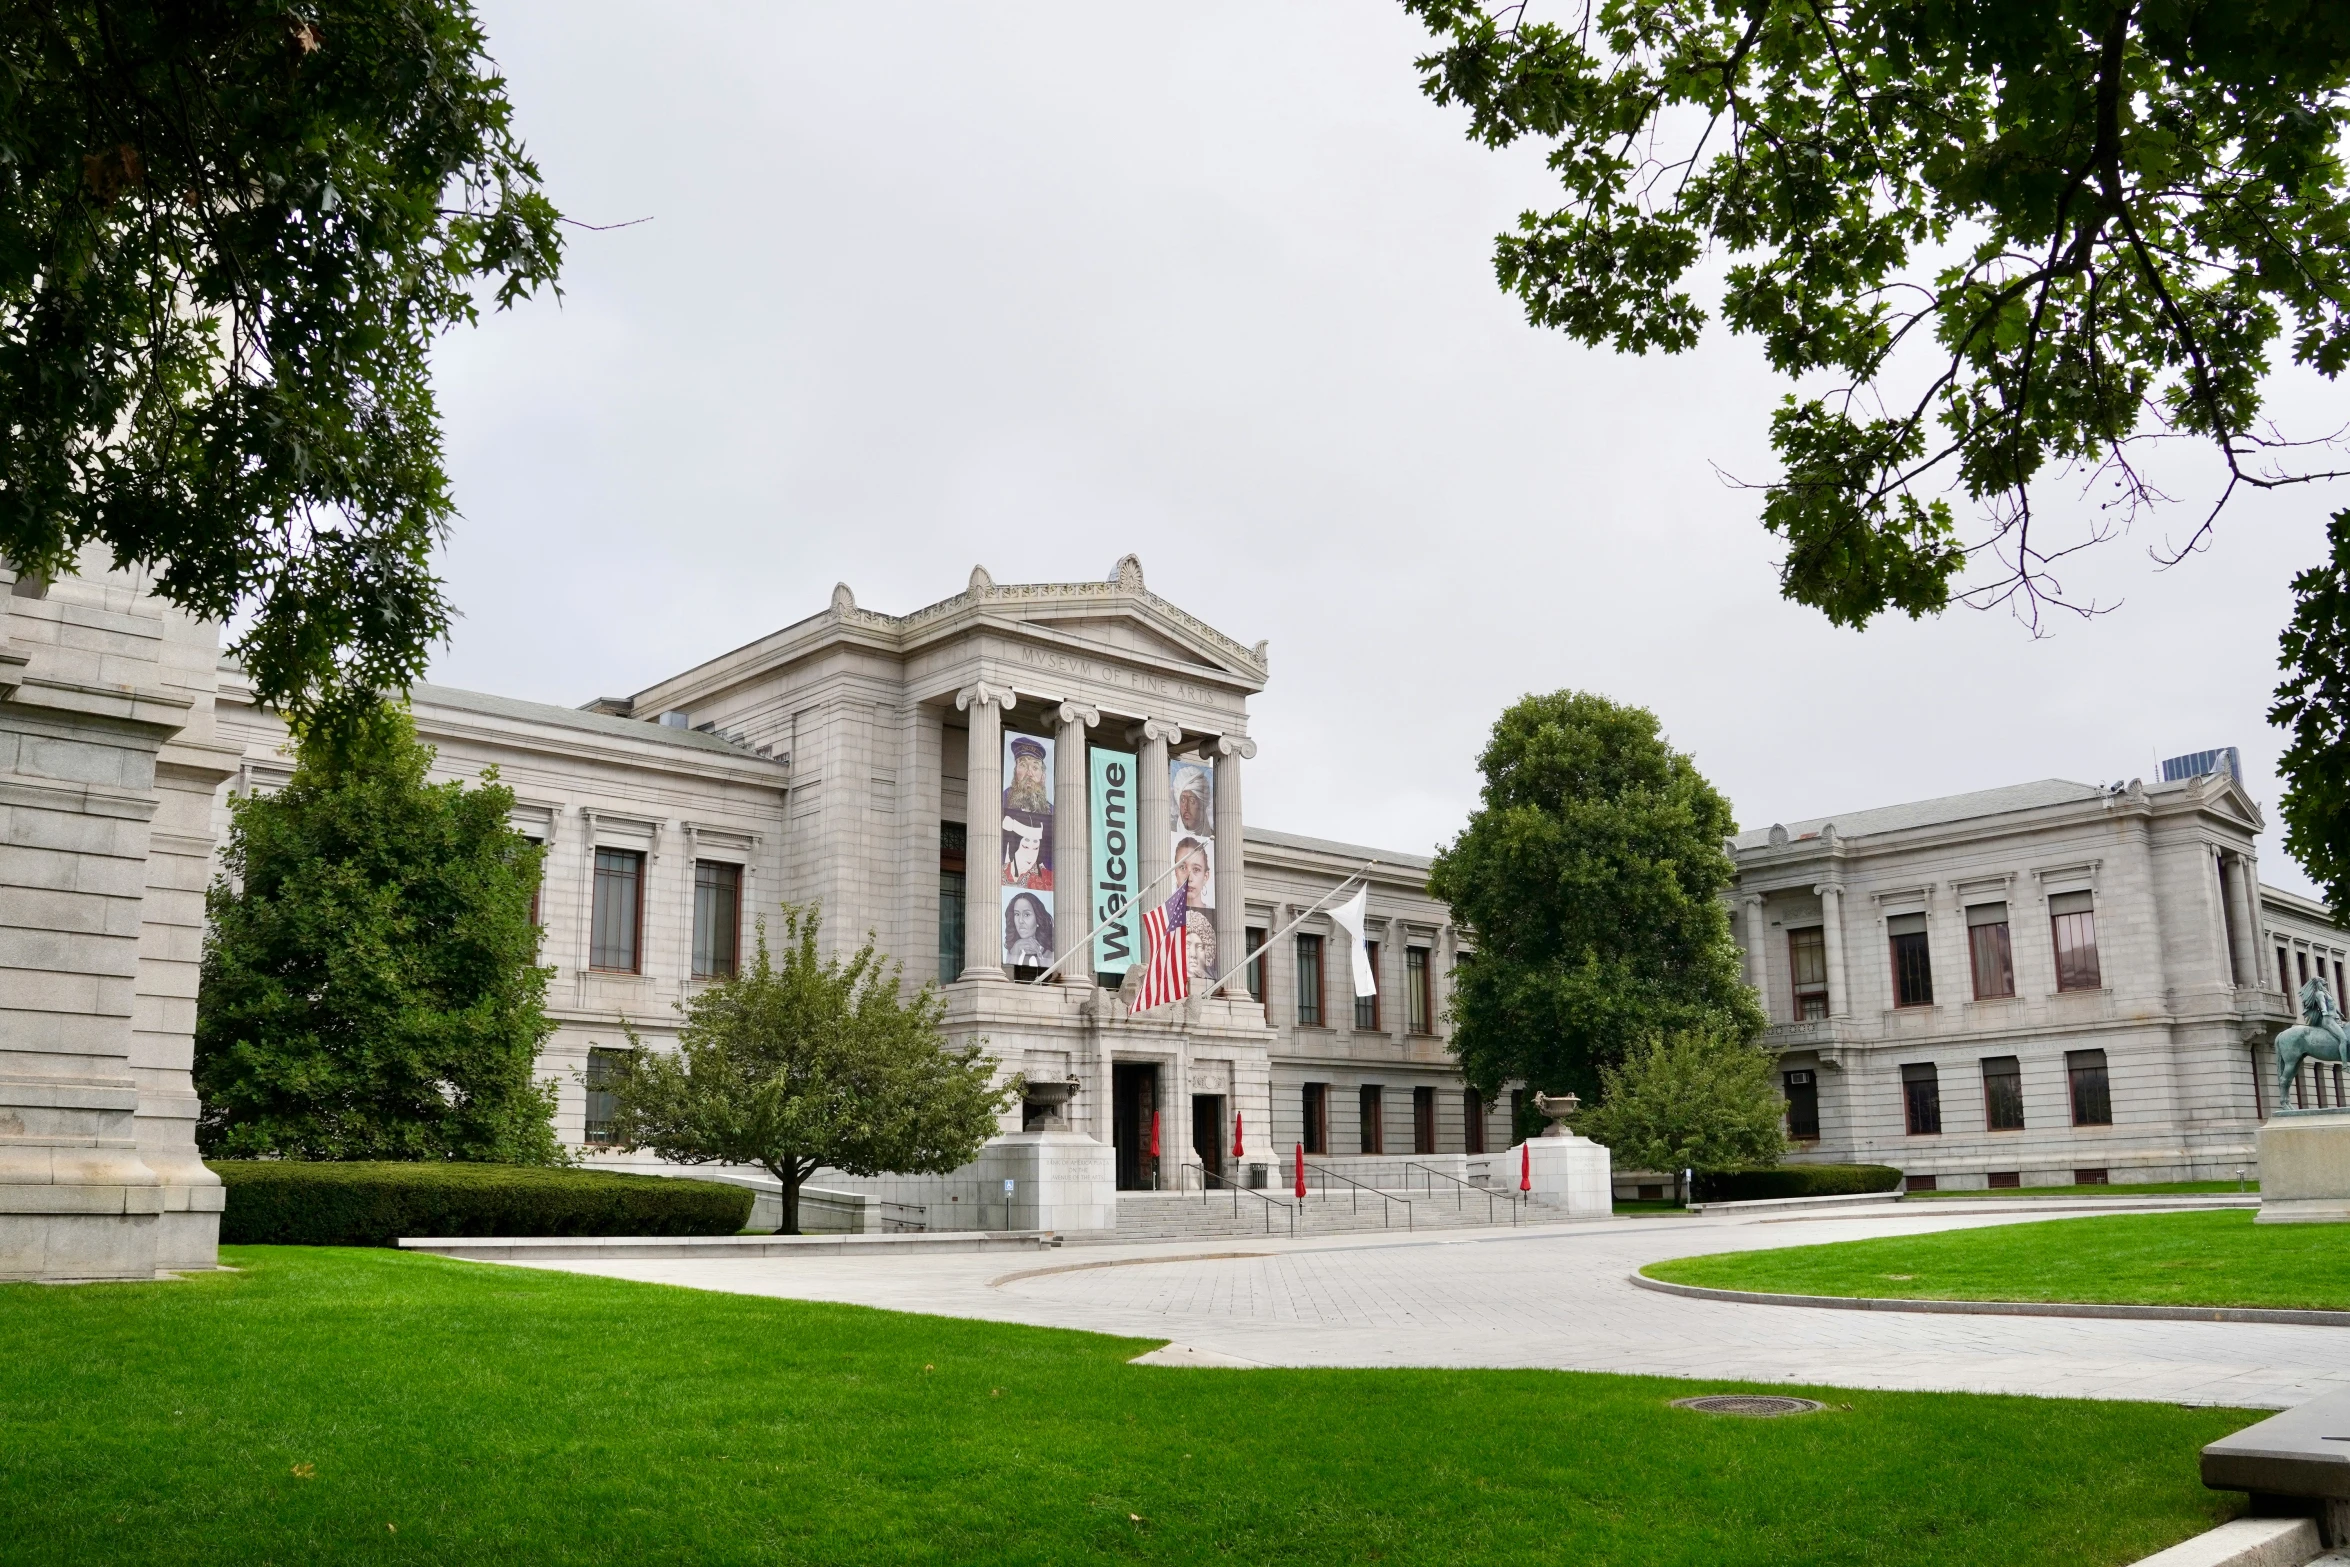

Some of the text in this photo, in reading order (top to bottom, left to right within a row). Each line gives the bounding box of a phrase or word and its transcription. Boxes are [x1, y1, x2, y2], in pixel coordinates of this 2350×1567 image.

[1022, 647, 1214, 704] MVSEVM OF FINE ARTS
[1099, 762, 1130, 962] Welcome
